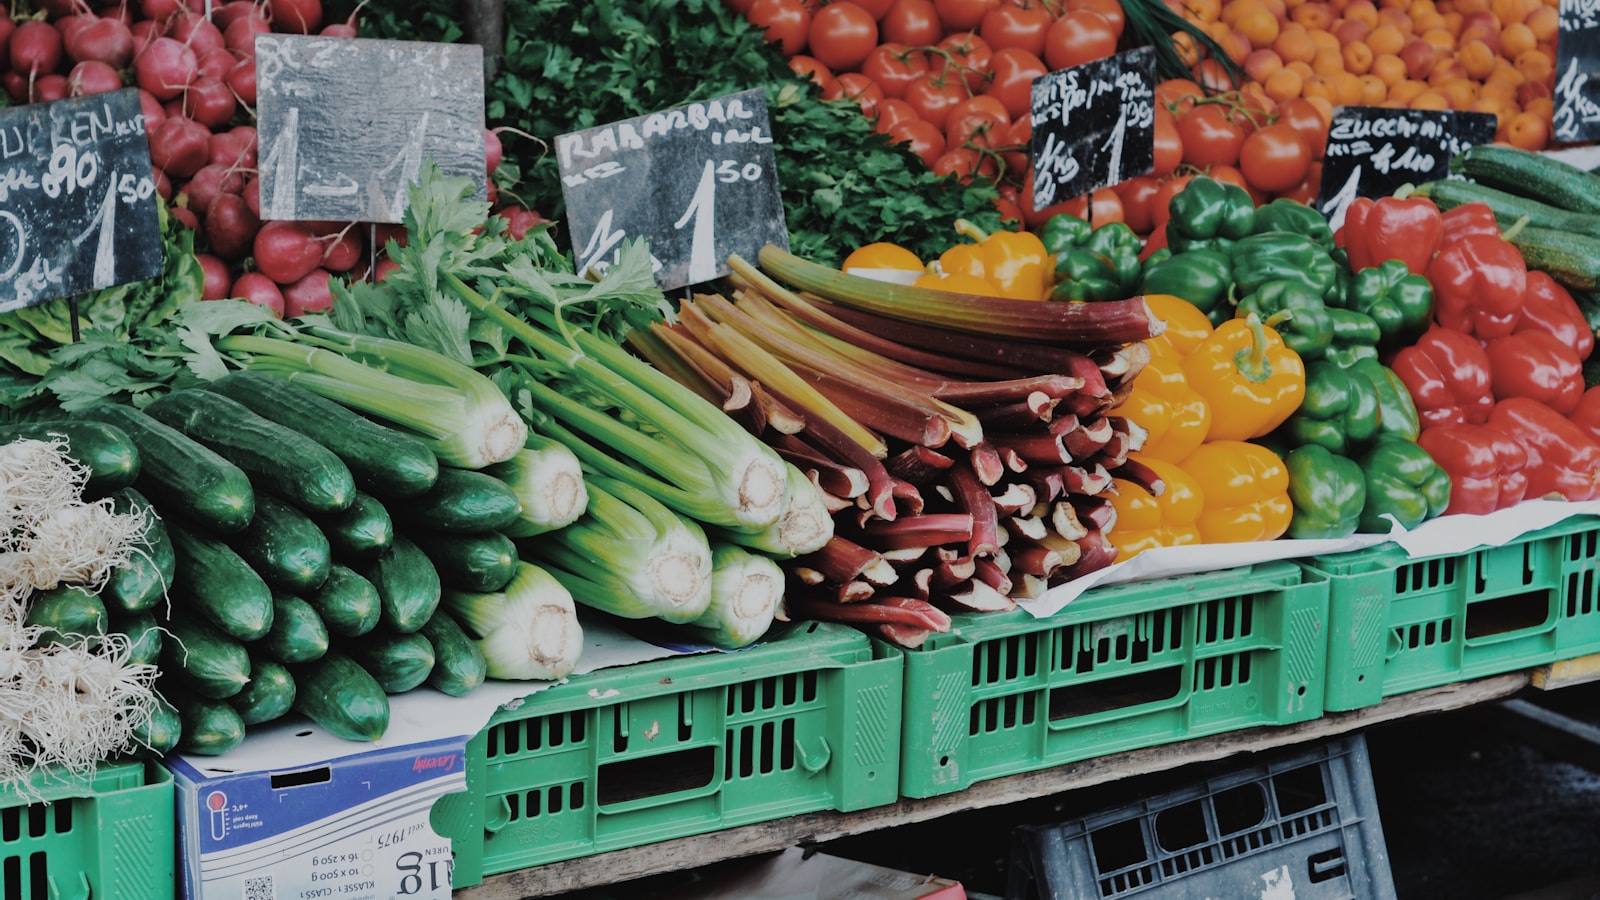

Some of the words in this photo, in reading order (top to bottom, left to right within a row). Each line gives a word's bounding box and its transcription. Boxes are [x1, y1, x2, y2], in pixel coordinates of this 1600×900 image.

[117, 173, 156, 204] 50
[407, 822, 425, 835] seit
[377, 828, 405, 850] 1975
[312, 857, 319, 866] g
[321, 854, 338, 865] 250
[340, 854, 347, 862] x
[348, 852, 358, 860] 16
[311, 871, 318, 882] g
[319, 869, 338, 880] 500
[340, 869, 347, 877] x
[349, 868, 359, 876] 10
[344, 881, 375, 893] KLASSE
[305, 887, 332, 900] CLASS
